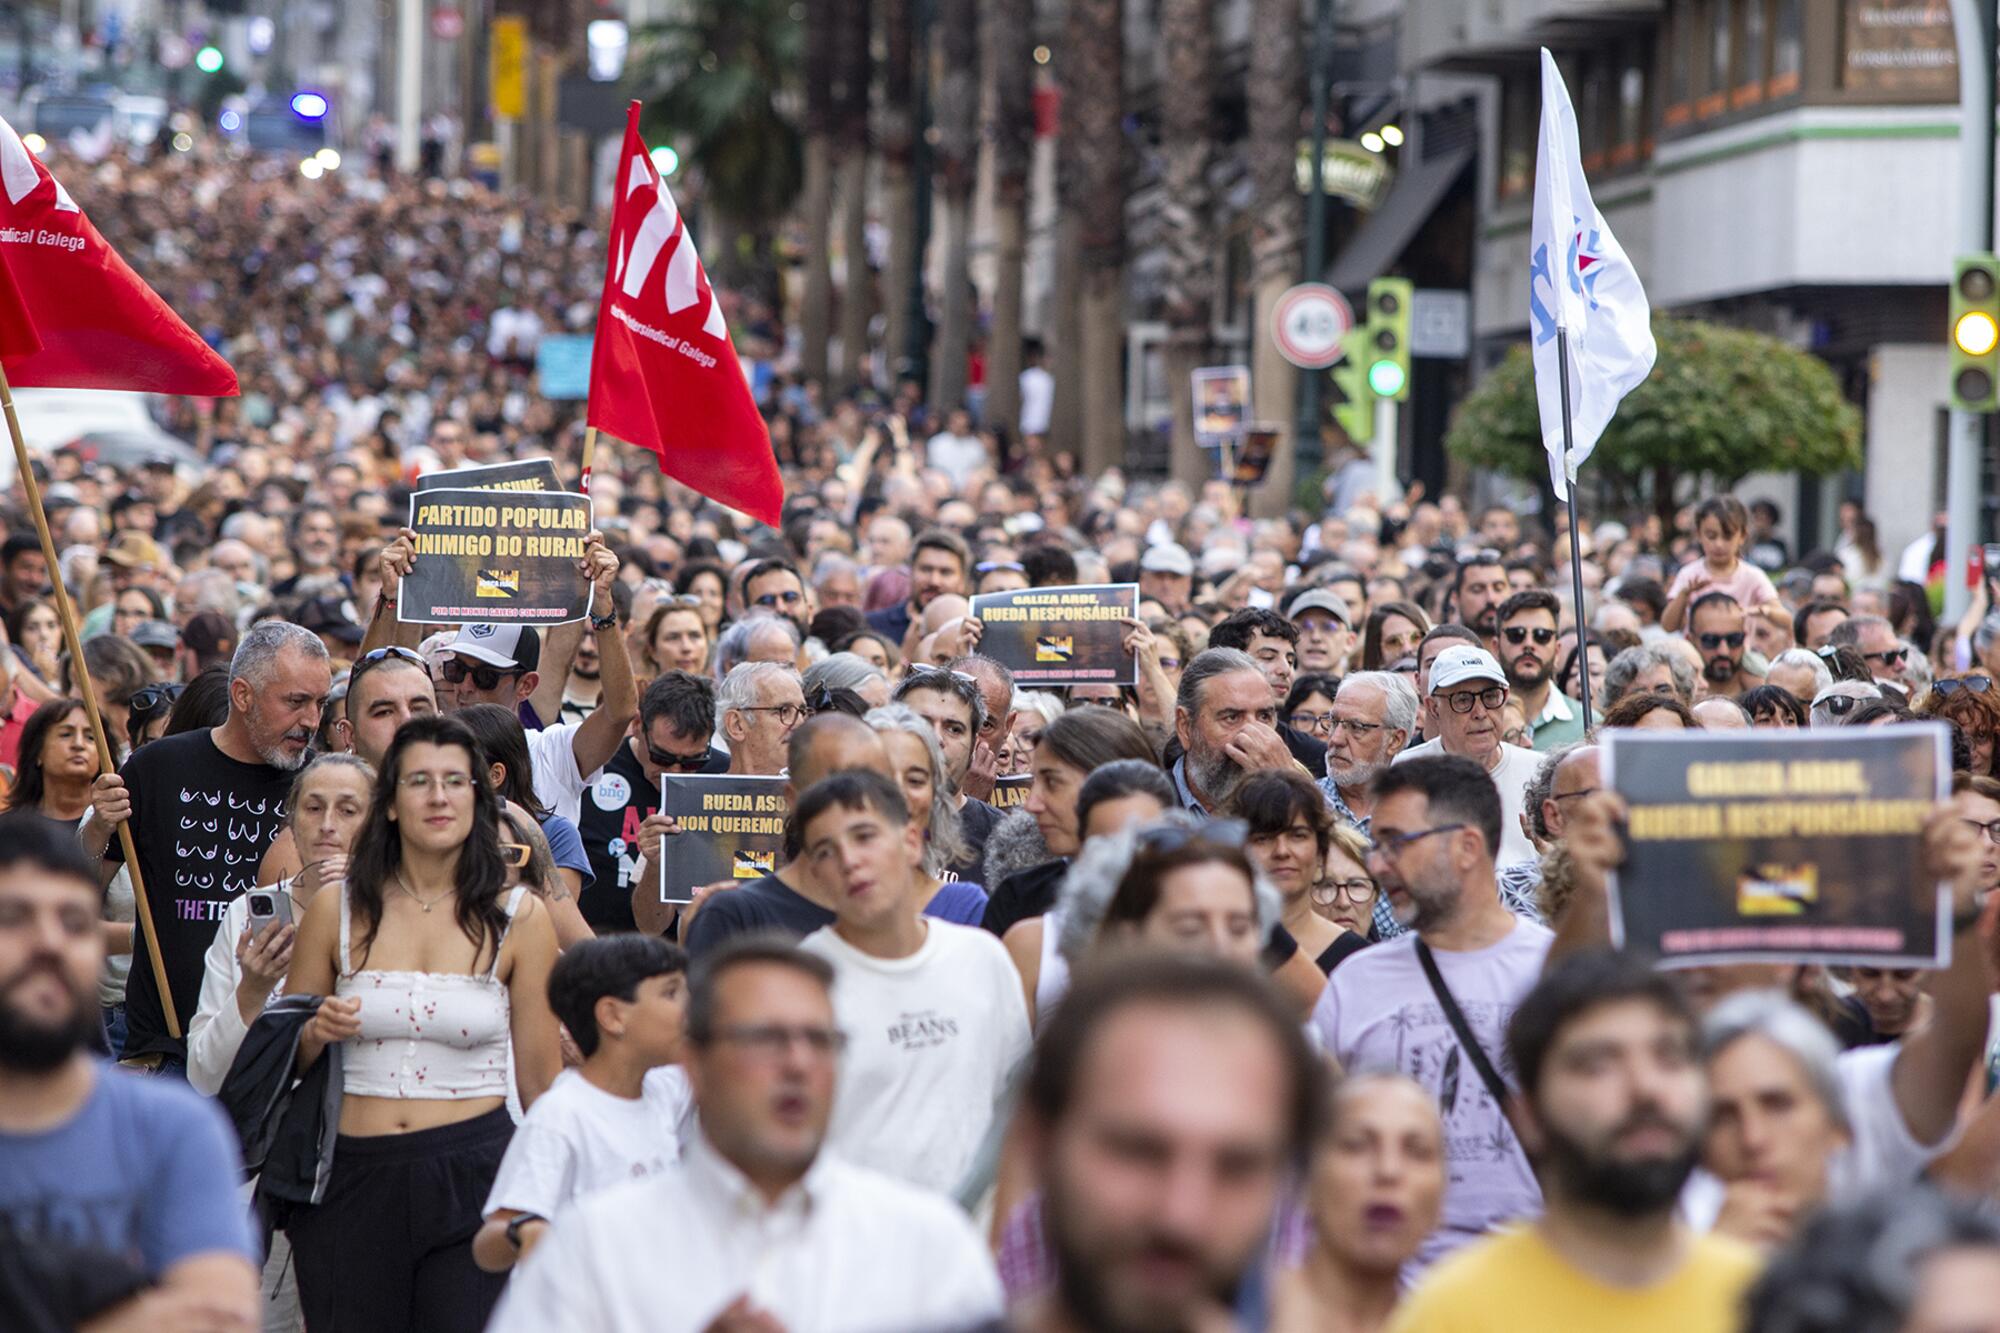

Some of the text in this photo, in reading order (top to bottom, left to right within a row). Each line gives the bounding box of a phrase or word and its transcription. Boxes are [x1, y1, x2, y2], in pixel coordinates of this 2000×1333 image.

[37, 230, 86, 251] Galega
[678, 341, 717, 368] Galega
[417, 505, 586, 529] PARTIDO POPULAR
[415, 534, 585, 558] INIMIGO DO RURAL
[1012, 595, 1059, 606] GALIZA
[983, 607, 1028, 621] RUEDA
[600, 784, 625, 801] bng
[703, 794, 787, 812] RUEDA ASU
[677, 815, 785, 834] NON QUEREMO
[176, 900, 231, 921] THETE
[887, 1018, 959, 1045] BEANS
